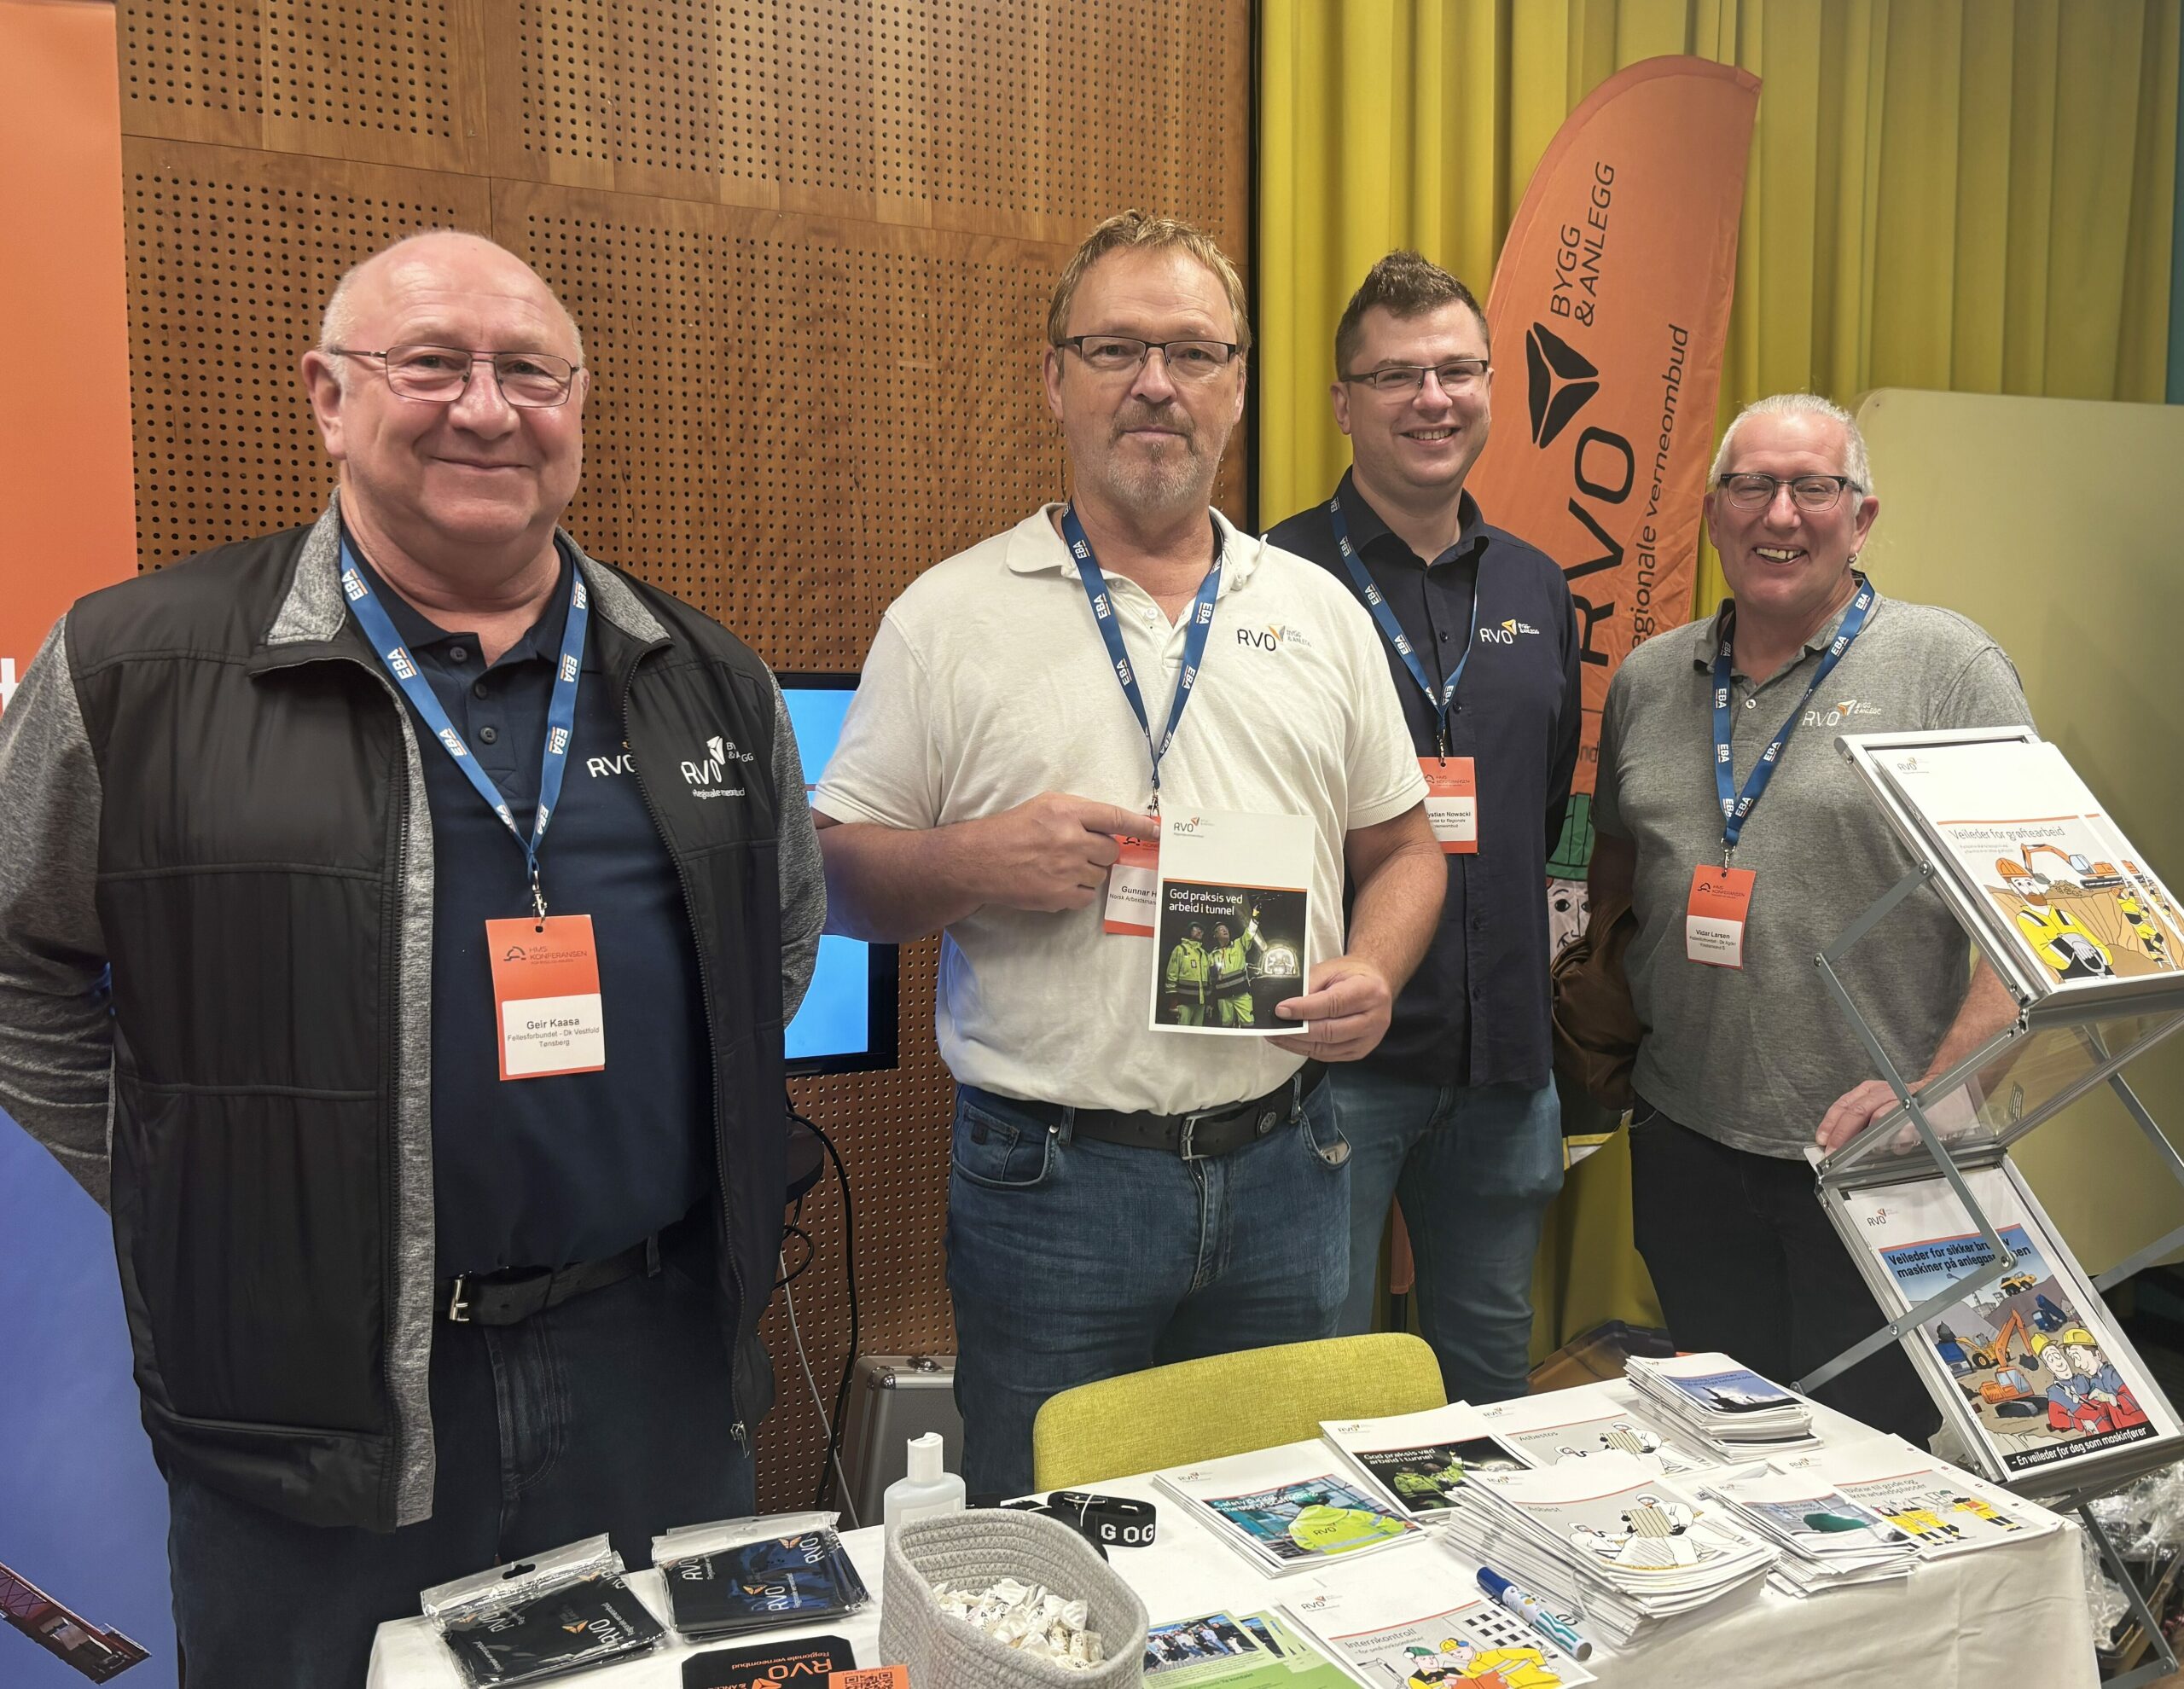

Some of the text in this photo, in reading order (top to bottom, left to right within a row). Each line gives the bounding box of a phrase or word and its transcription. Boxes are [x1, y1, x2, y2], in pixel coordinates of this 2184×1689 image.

[1550, 223, 1581, 317] BYGG
[1625, 323, 1689, 655] egionale verneombud
[1073, 541, 1086, 560] EBA
[1339, 537, 1350, 557] EBA
[1566, 426, 1635, 667] RVO
[341, 569, 365, 601] EBA
[1365, 585, 1379, 606] EBA
[575, 583, 587, 610] EBA
[1093, 594, 1110, 619] EBA
[1856, 593, 1869, 611] EBA
[1199, 602, 1212, 624] EBA
[1237, 629, 1276, 652] RVO
[1395, 636, 1409, 655] EBA
[1479, 628, 1513, 644] RVO
[1832, 636, 1846, 656] EBA
[387, 649, 413, 680] EBA
[565, 655, 578, 683] EBA
[1117, 660, 1131, 686] EBA
[1183, 668, 1195, 689] EBA
[1718, 688, 1727, 710] EBA
[1802, 711, 1840, 727] RVO
[439, 728, 463, 757] EBA
[552, 727, 568, 755] EBA
[1763, 741, 1779, 762] EBA
[1719, 744, 1728, 763] EBA
[681, 757, 723, 785] RVO
[1735, 797, 1751, 817] EBA
[1174, 822, 1194, 833] RVO
[1949, 828, 1990, 840] Veileder
[1990, 828, 2006, 839] for
[1122, 885, 1150, 897] Gunnar
[1170, 888, 1189, 900] God
[1190, 891, 1224, 903] praksis
[1225, 894, 1243, 904] ved
[1169, 901, 1199, 913] arbeid
[1205, 904, 1234, 915] tunnel
[1711, 931, 1730, 939] Larsen
[530, 950, 588, 961] KONFERANSEN
[507, 1030, 558, 1042] Fellesforbundet
[563, 1029, 574, 1037] Dk
[574, 1026, 600, 1036] Vestfold
[526, 1018, 580, 1030] Geir Kaasa
[539, 1039, 570, 1049] Tønsberg
[1867, 1215, 1887, 1227] RVO
[1888, 1249, 1930, 1266] Veileder
[1929, 1246, 1946, 1259] for
[1947, 1242, 1975, 1256] sikker
[1896, 1262, 1945, 1279] maskiner
[1945, 1257, 1959, 1273] på
[1384, 1450, 1418, 1460] praksis
[1417, 1448, 1436, 1456] ved
[2018, 1455, 2030, 1466] En
[2029, 1448, 2058, 1464] veileder
[2056, 1445, 2071, 1460] for
[2070, 1443, 2086, 1454] deg
[2085, 1439, 2104, 1450] som
[2103, 1426, 2147, 1445] maskinfører
[1403, 1454, 1434, 1462] tunnel
[1313, 1526, 1337, 1536] RVO
[799, 1536, 825, 1564] RVO
[764, 1586, 790, 1611] RVO
[1301, 1600, 1325, 1611] RVO
[589, 1618, 624, 1645] RVO
[1345, 1628, 1417, 1649] Internkontroll
[731, 1651, 830, 1670] Regionale verneombud
[768, 1658, 833, 1680] RVO
